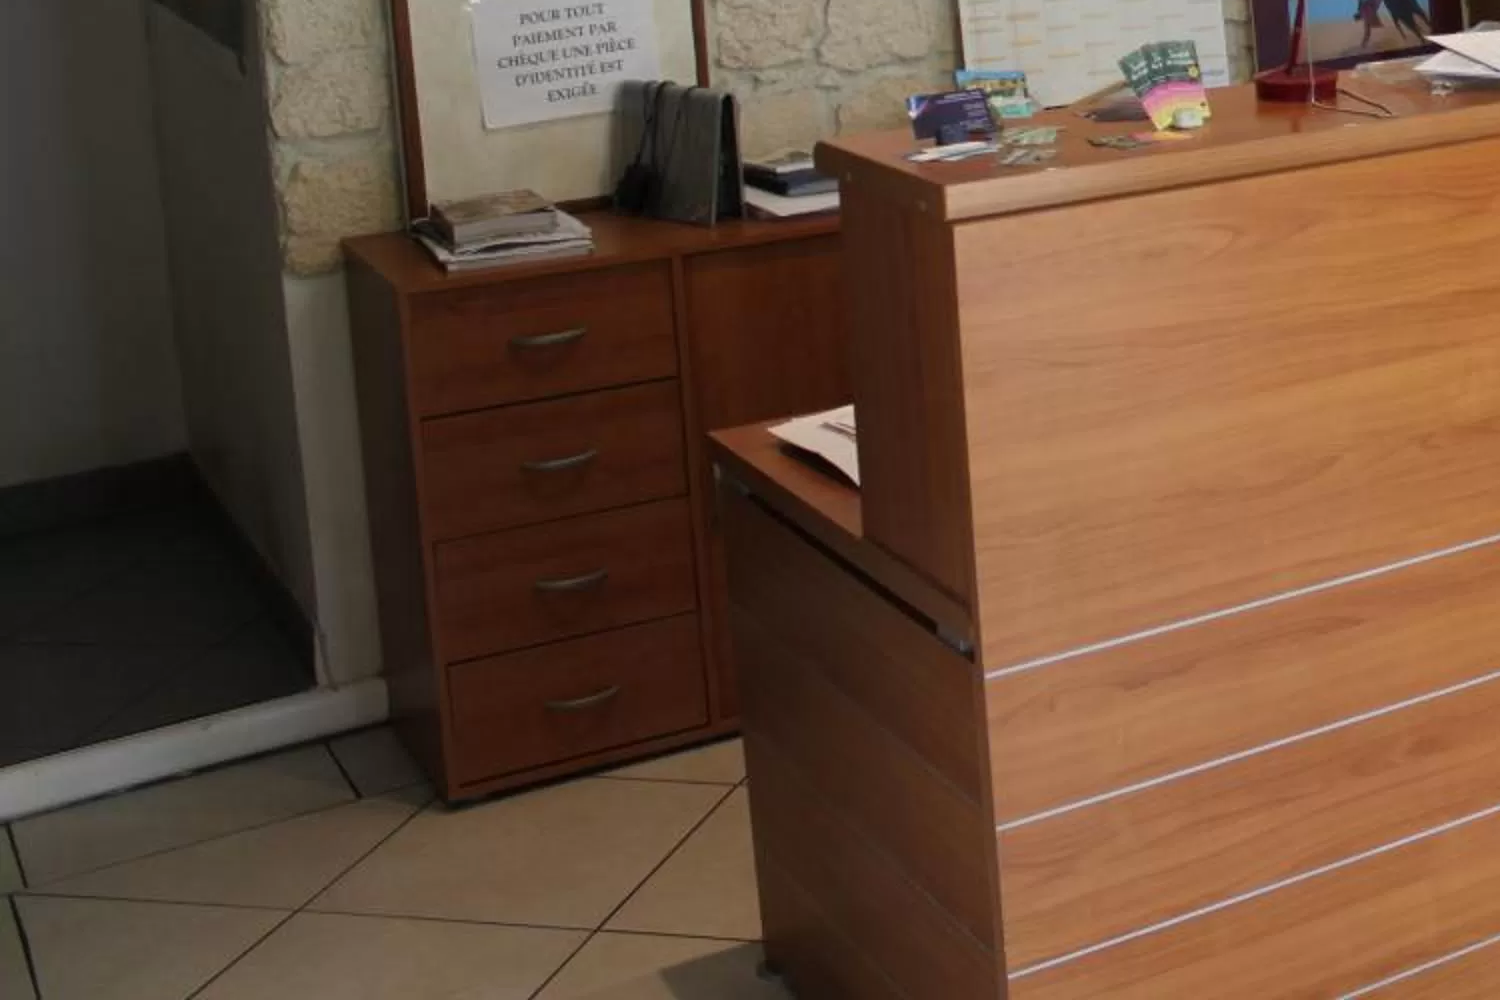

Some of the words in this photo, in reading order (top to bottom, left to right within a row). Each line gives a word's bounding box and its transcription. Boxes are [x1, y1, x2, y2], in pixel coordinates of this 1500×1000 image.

[519, 8, 560, 25] POUR
[564, 2, 605, 19] TOUT
[588, 21, 618, 36] PAR
[562, 44, 593, 58] UNE
[599, 59, 625, 73] EST
